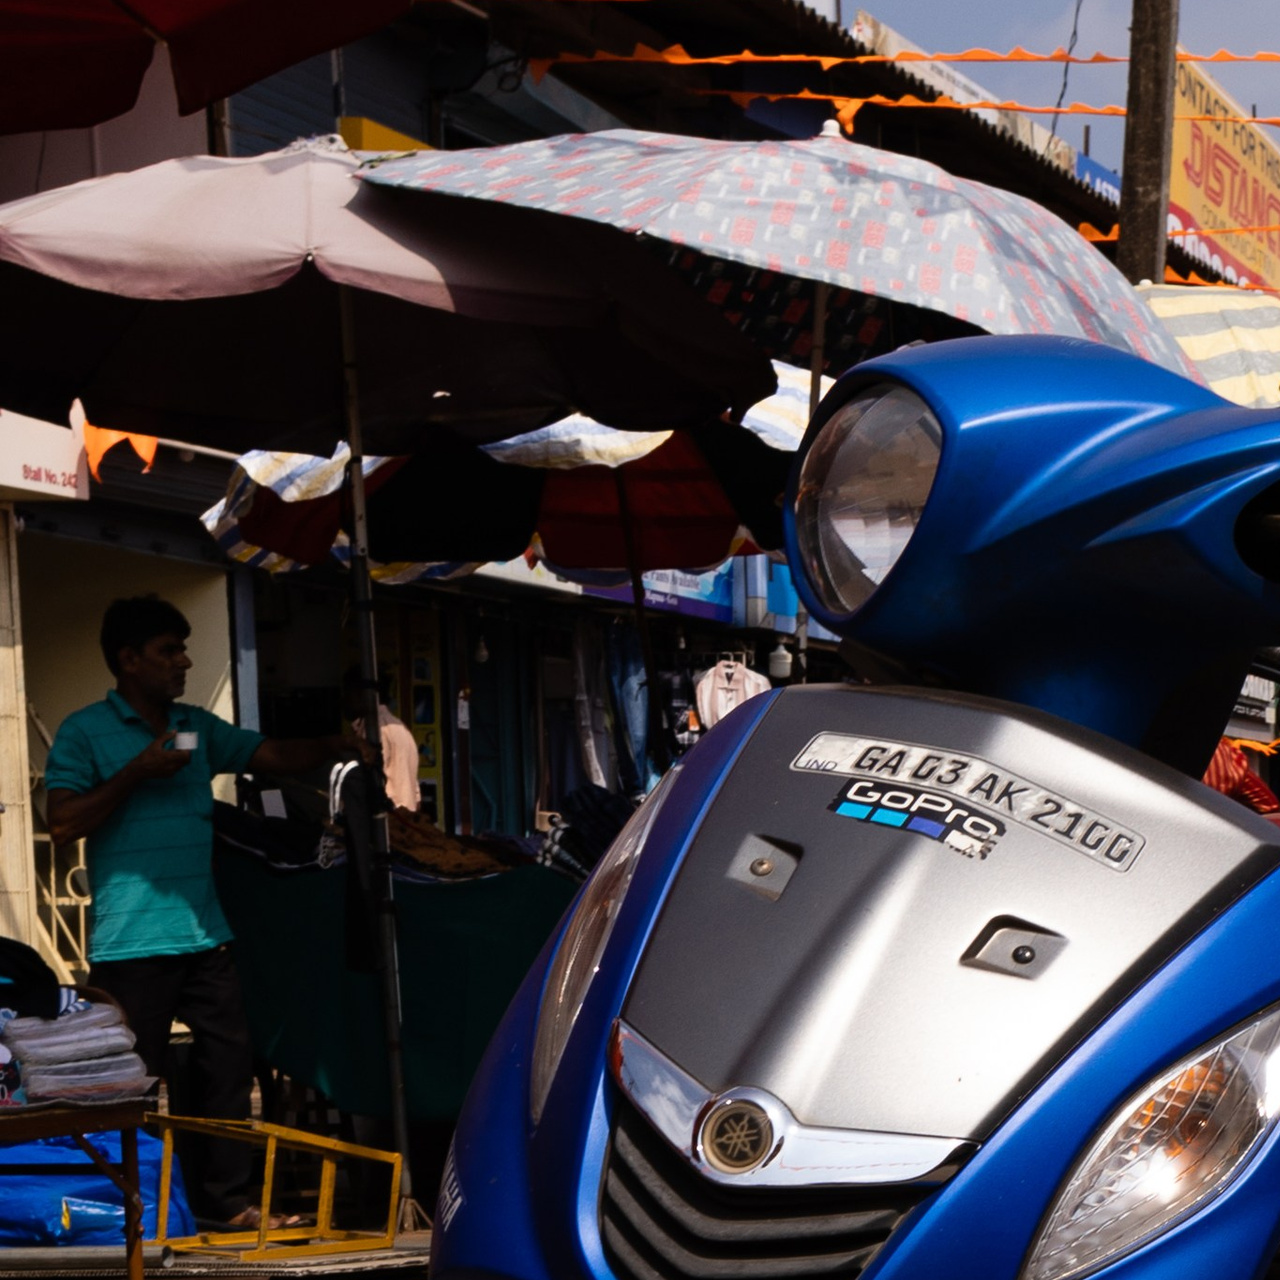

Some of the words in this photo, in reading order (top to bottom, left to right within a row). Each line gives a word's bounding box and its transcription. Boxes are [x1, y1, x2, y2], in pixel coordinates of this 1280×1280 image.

[1177, 63, 1229, 138] ONTACT
[1232, 117, 1256, 167] FOR
[803, 757, 838, 771] IND
[853, 744, 907, 776] GA
[967, 772, 1029, 812] AK
[846, 780, 1000, 840] GoPro
